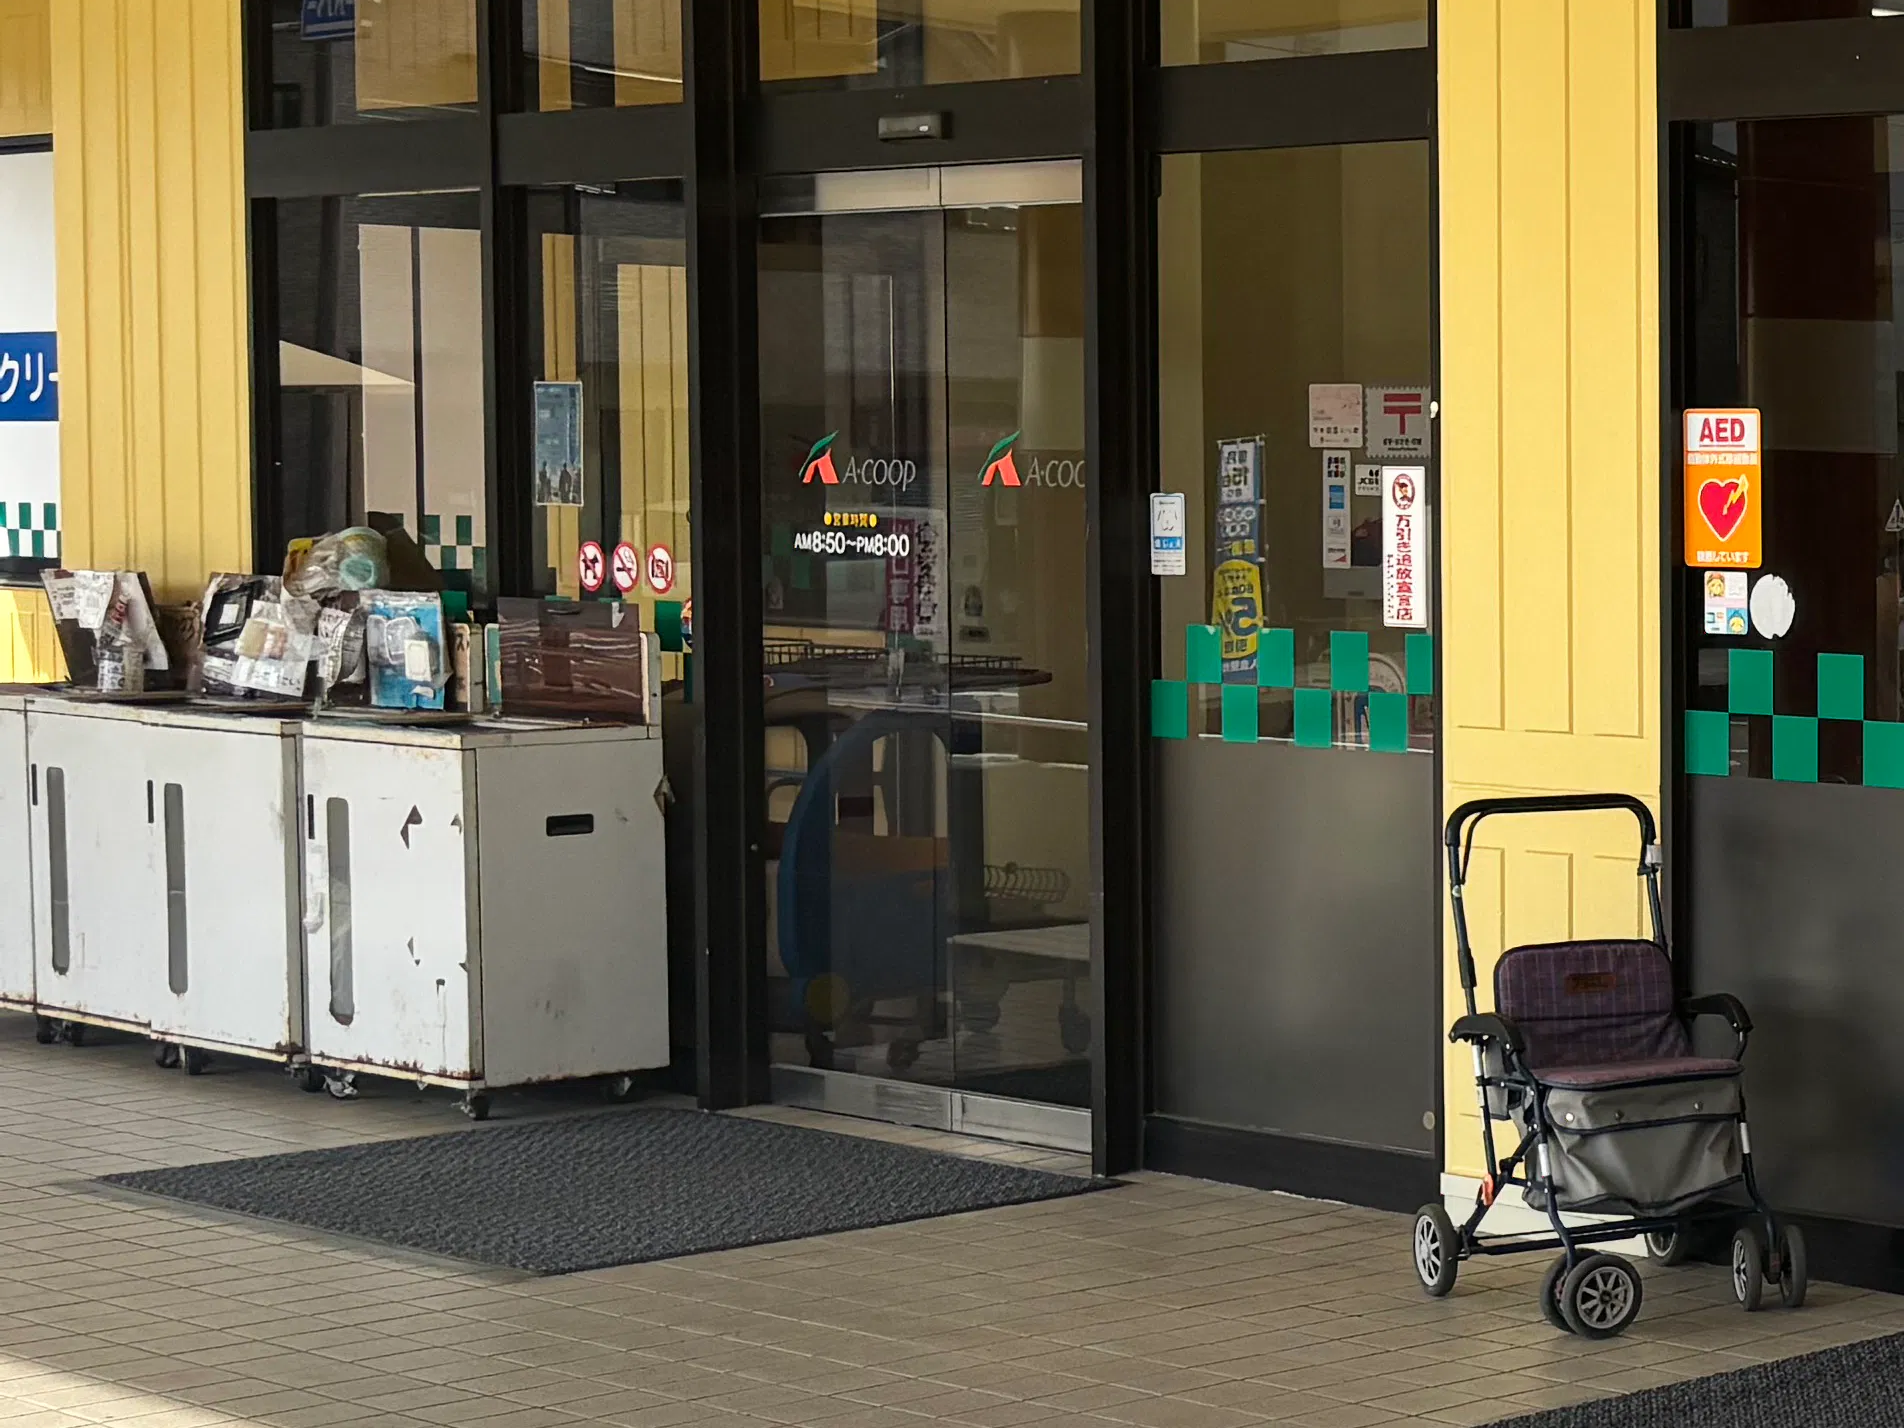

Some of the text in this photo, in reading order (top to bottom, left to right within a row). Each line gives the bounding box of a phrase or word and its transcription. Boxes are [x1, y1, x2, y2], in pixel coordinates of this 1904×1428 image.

[0, 352, 58, 403] クリ
[1700, 418, 1745, 443] AED
[1395, 514, 1413, 621] 万引き追放宣言店
